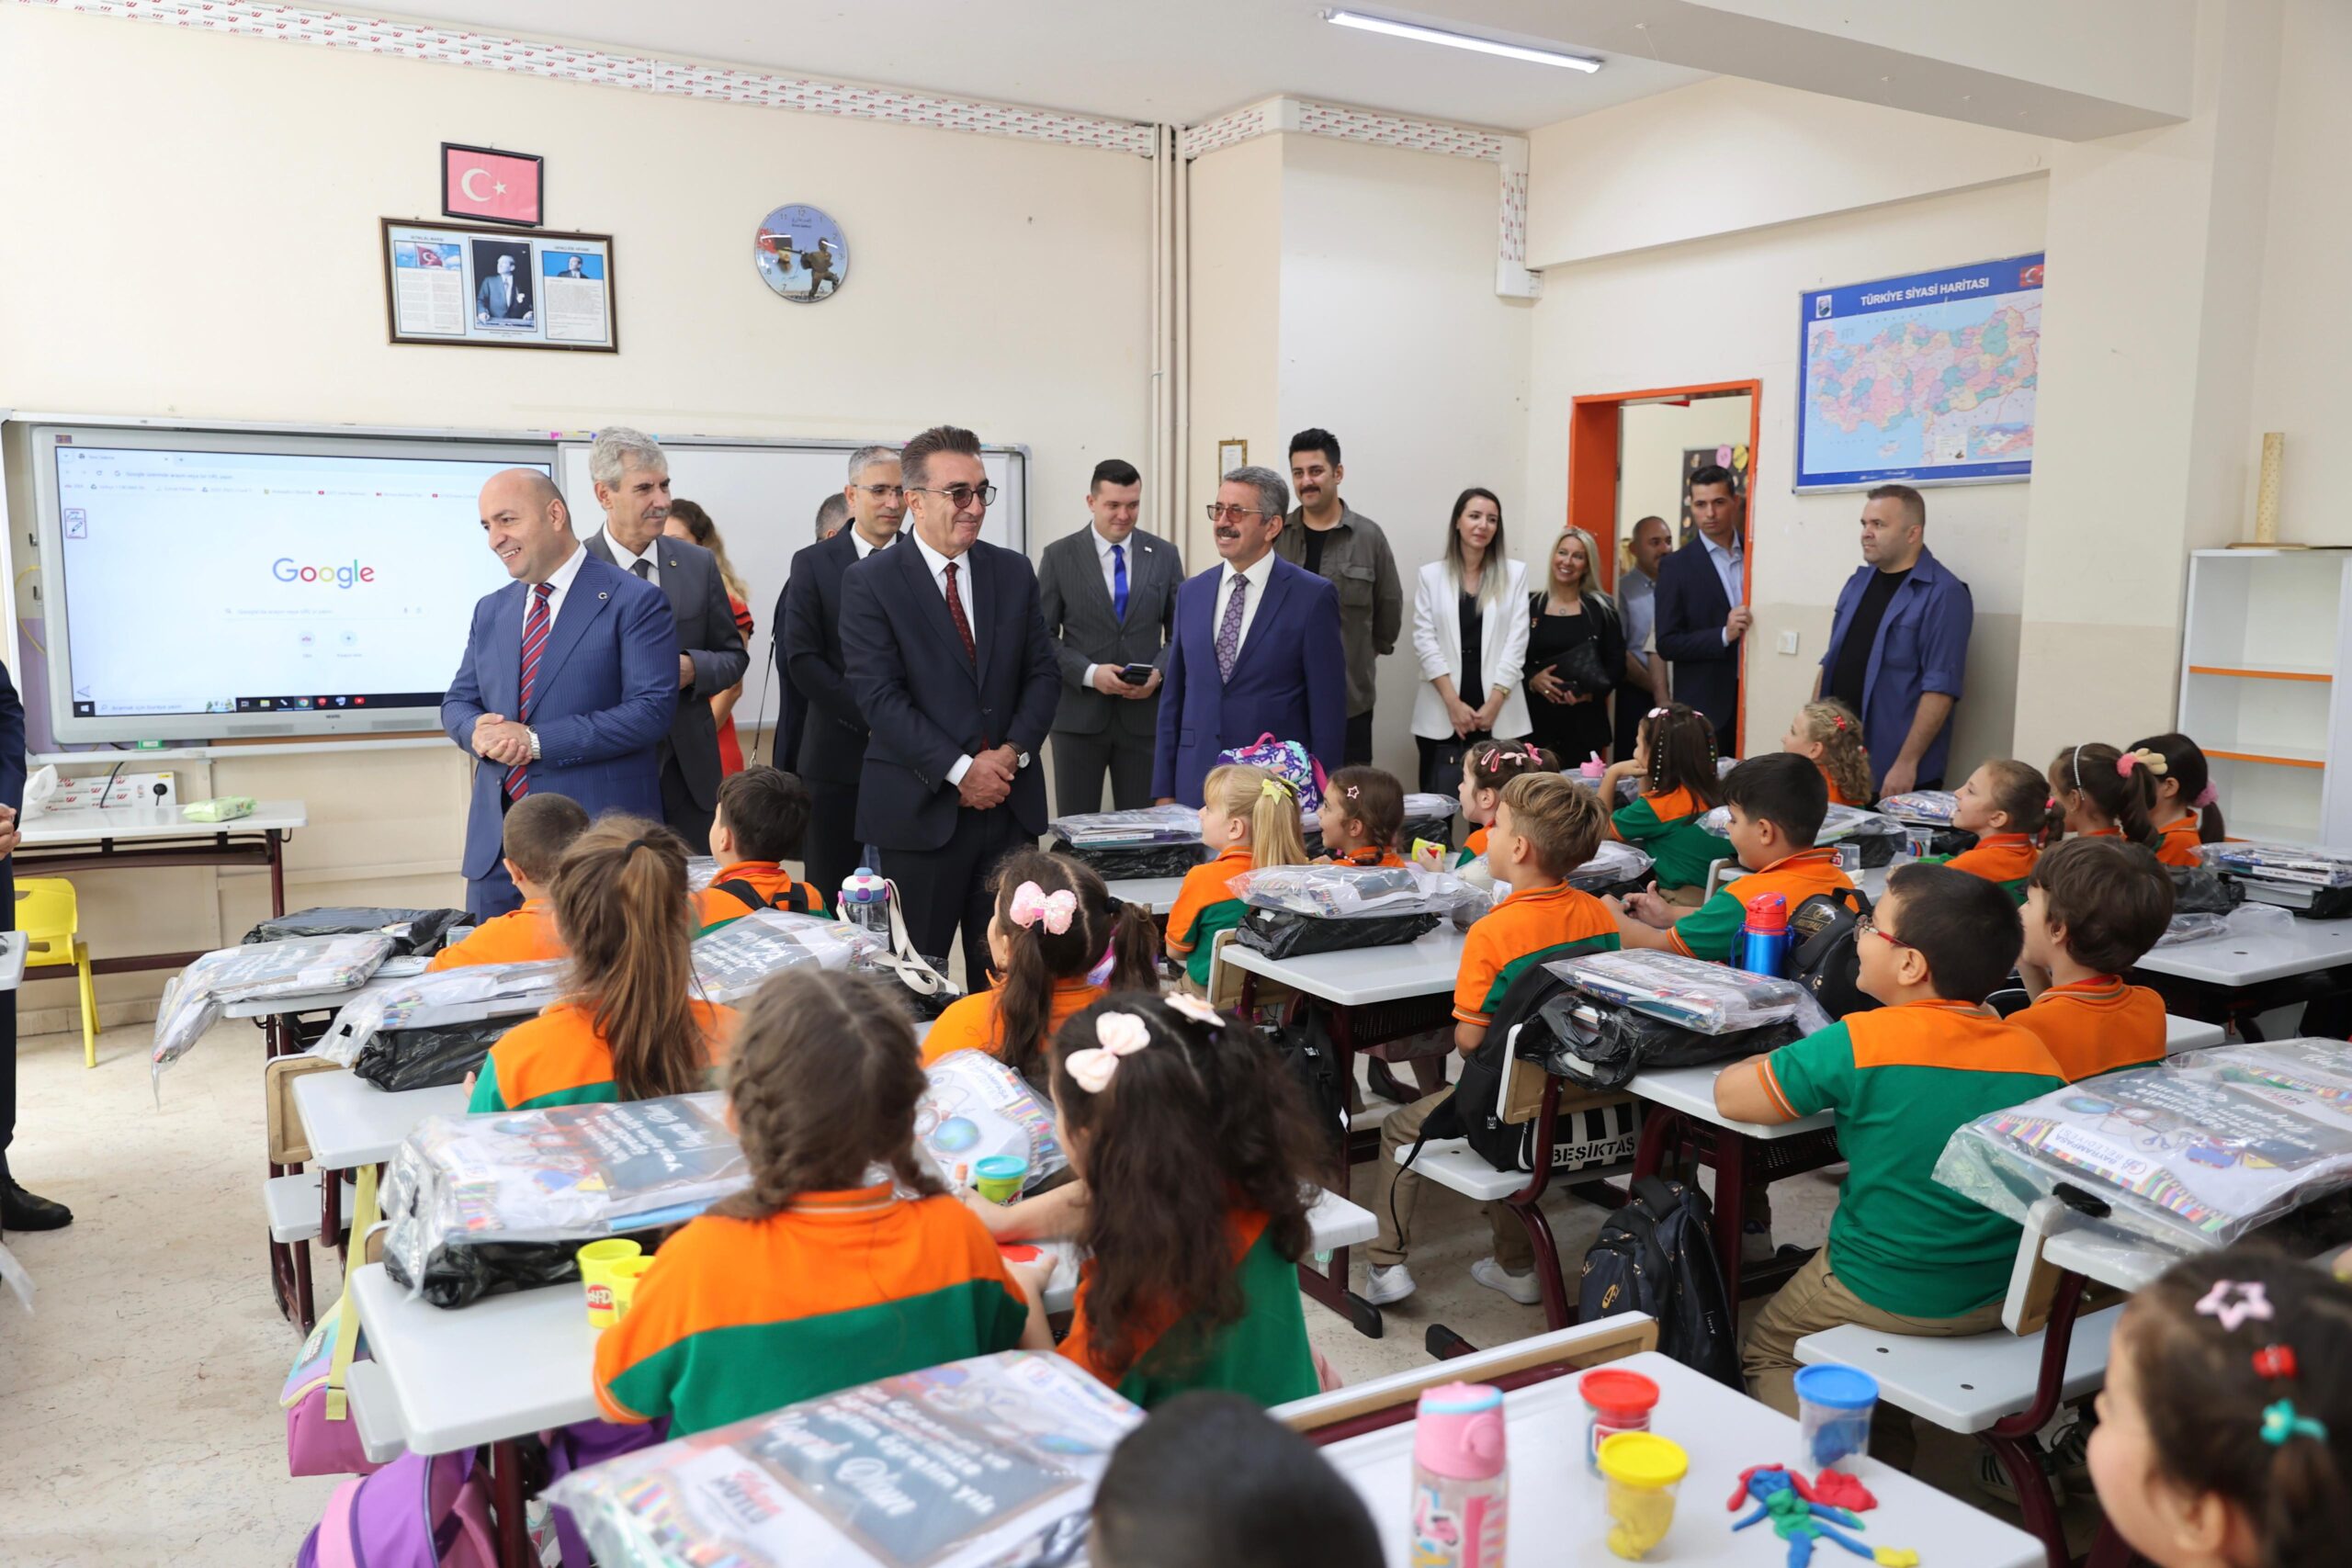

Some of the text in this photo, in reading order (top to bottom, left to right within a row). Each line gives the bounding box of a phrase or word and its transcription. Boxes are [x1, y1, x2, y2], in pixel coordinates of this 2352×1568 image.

[1860, 277, 1990, 307] TÜRKİYE SİYASİ HARİTASI
[272, 558, 375, 590] Google
[1553, 1136, 1635, 1163] BEŞİKTAŞ
